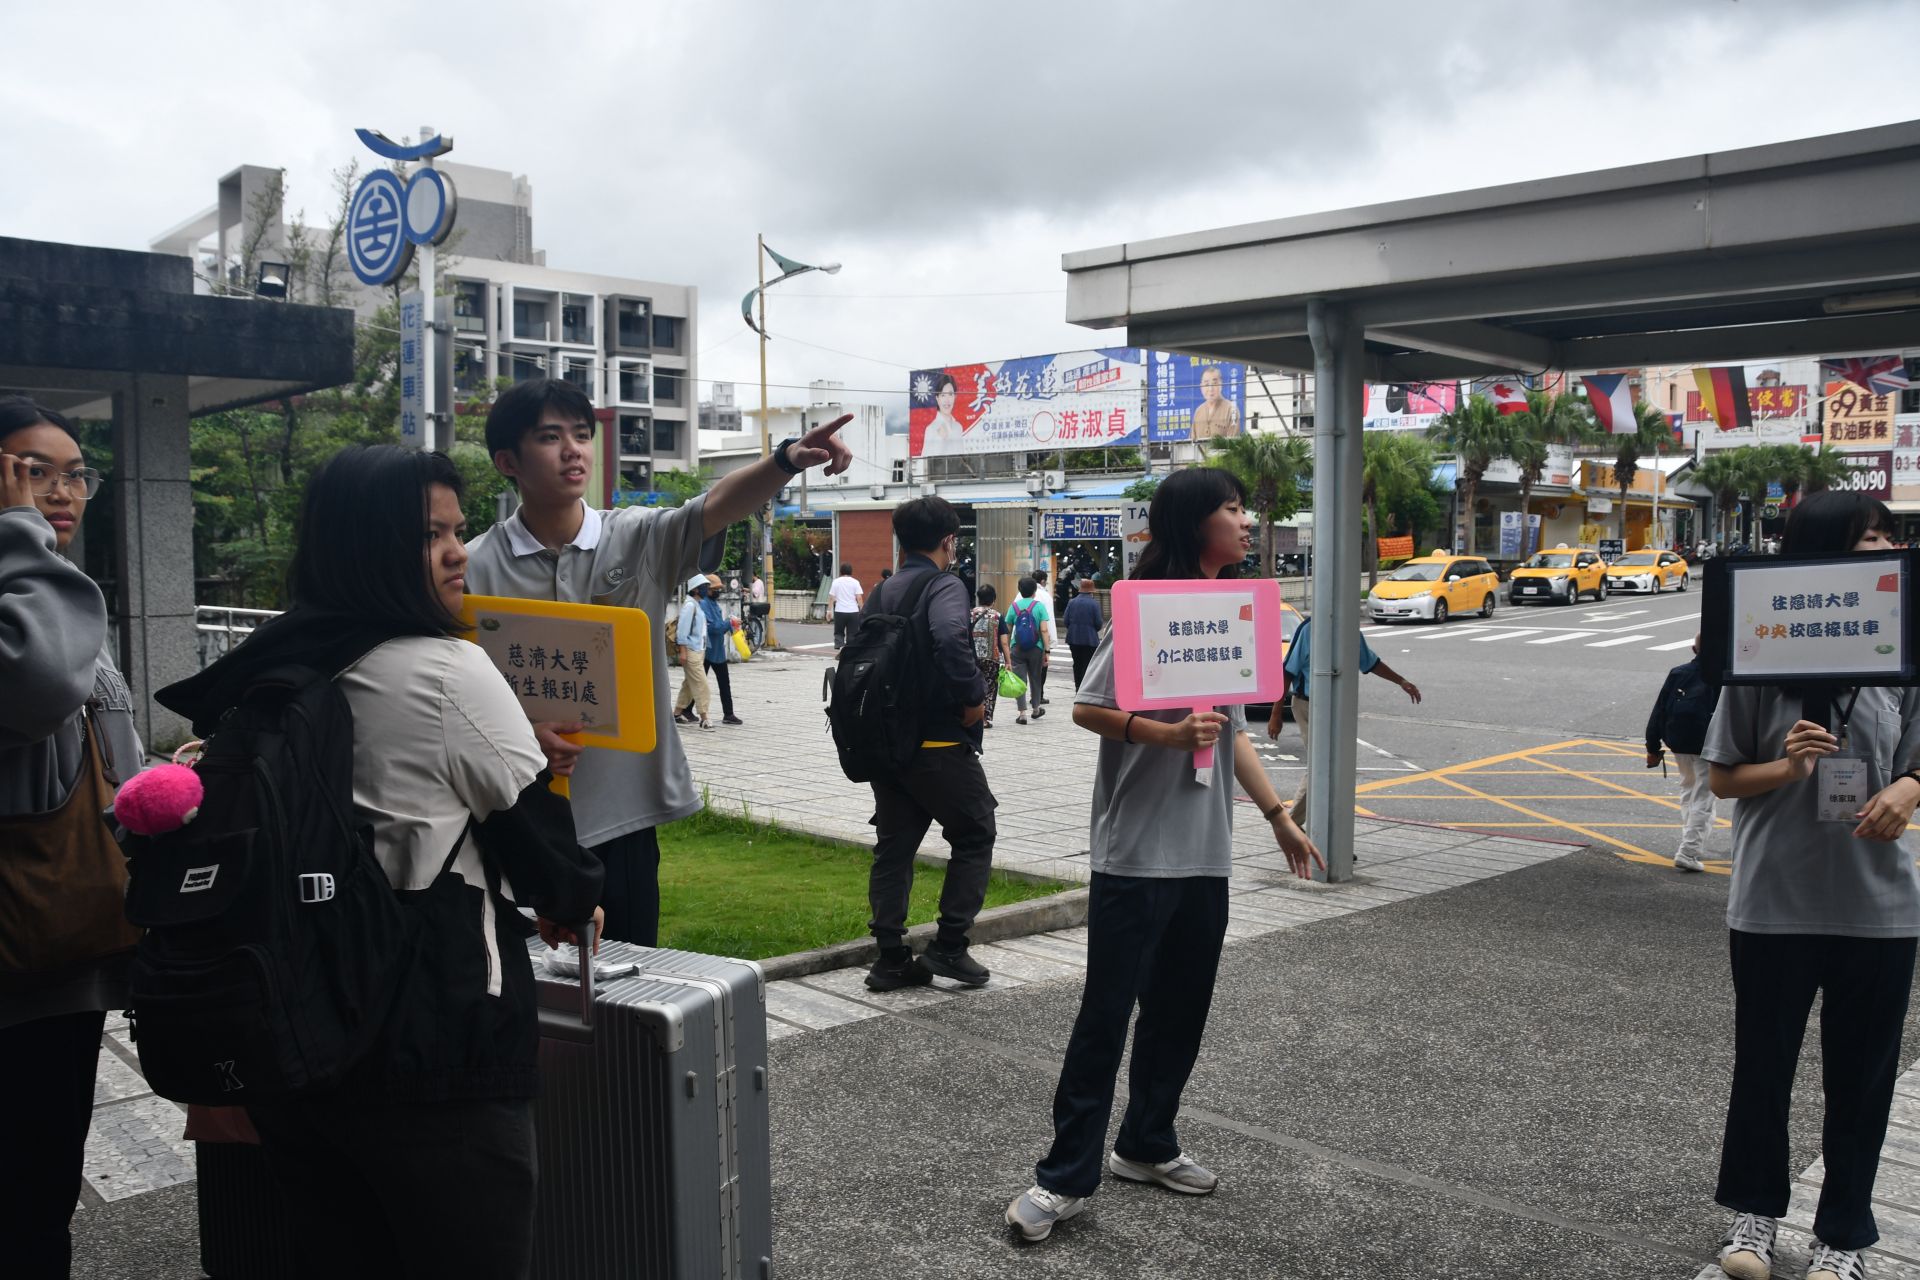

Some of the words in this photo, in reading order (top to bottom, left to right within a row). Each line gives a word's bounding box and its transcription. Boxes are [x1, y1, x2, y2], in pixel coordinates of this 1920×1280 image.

[402, 303, 416, 435] 花蓮車站
[1859, 394, 1889, 412] 黃金
[1057, 407, 1128, 440] 游淑貞
[1828, 470, 1887, 491] 8090
[1127, 507, 1149, 519] TA
[1045, 515, 1099, 537] 機車一日20元
[1771, 591, 1860, 611] 往慈濟大學
[1168, 619, 1229, 636] 往慈濟大學
[1754, 619, 1880, 640] 中央校區接駁車
[508, 643, 590, 676] 慈濟大學
[1156, 645, 1243, 664] 介仁校區接駁車
